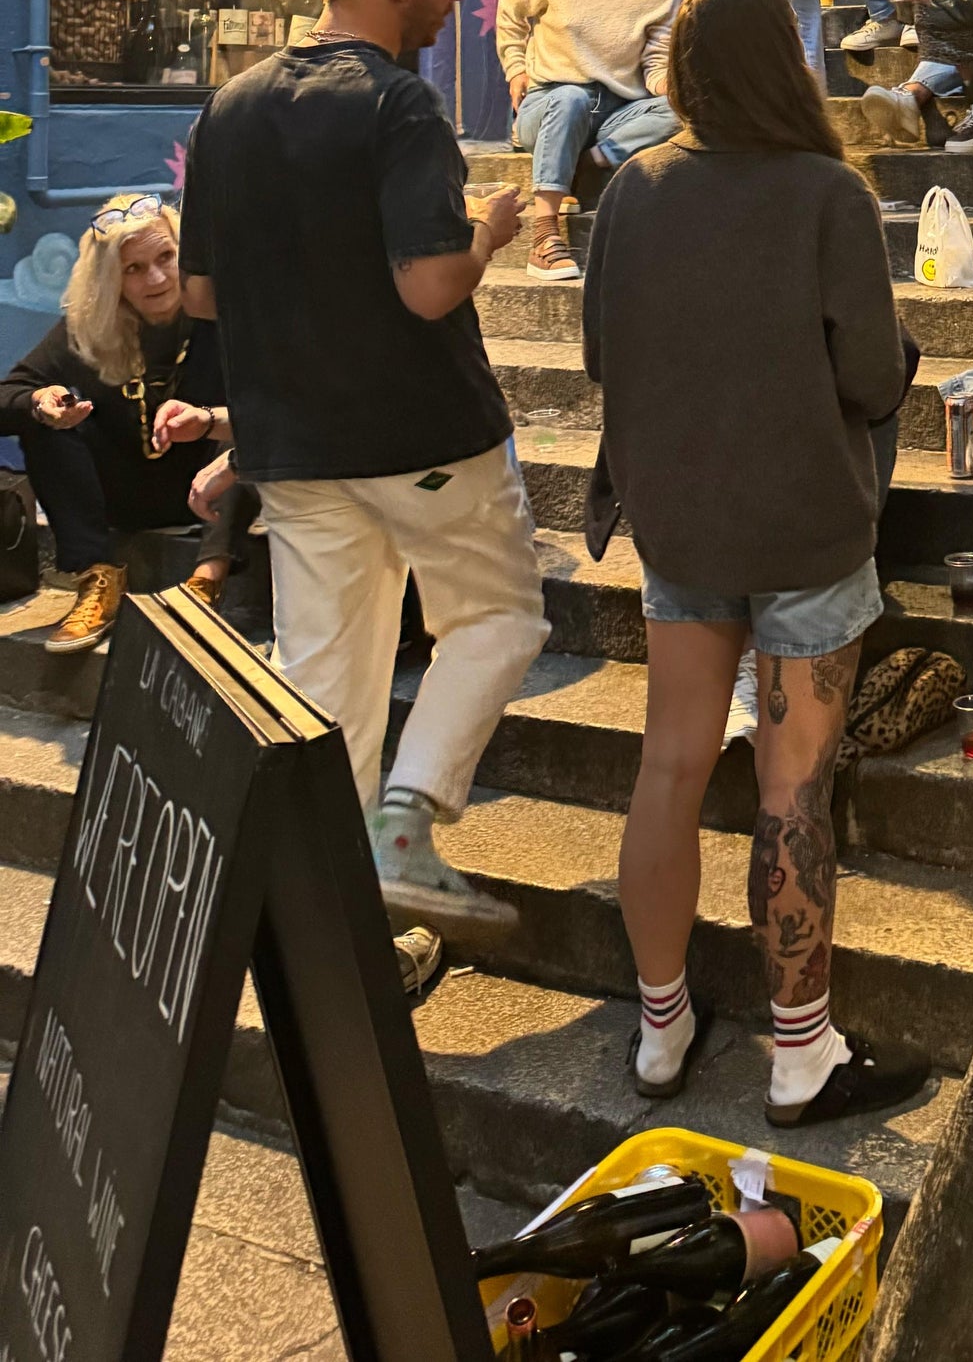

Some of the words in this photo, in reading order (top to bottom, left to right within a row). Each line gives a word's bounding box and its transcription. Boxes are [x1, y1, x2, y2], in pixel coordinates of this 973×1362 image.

[139, 644, 160, 694] LA
[160, 664, 213, 759] CABANE
[131, 799, 223, 1045] OPEN
[35, 1006, 92, 1188] NATURAL
[87, 1148, 125, 1298] WINE
